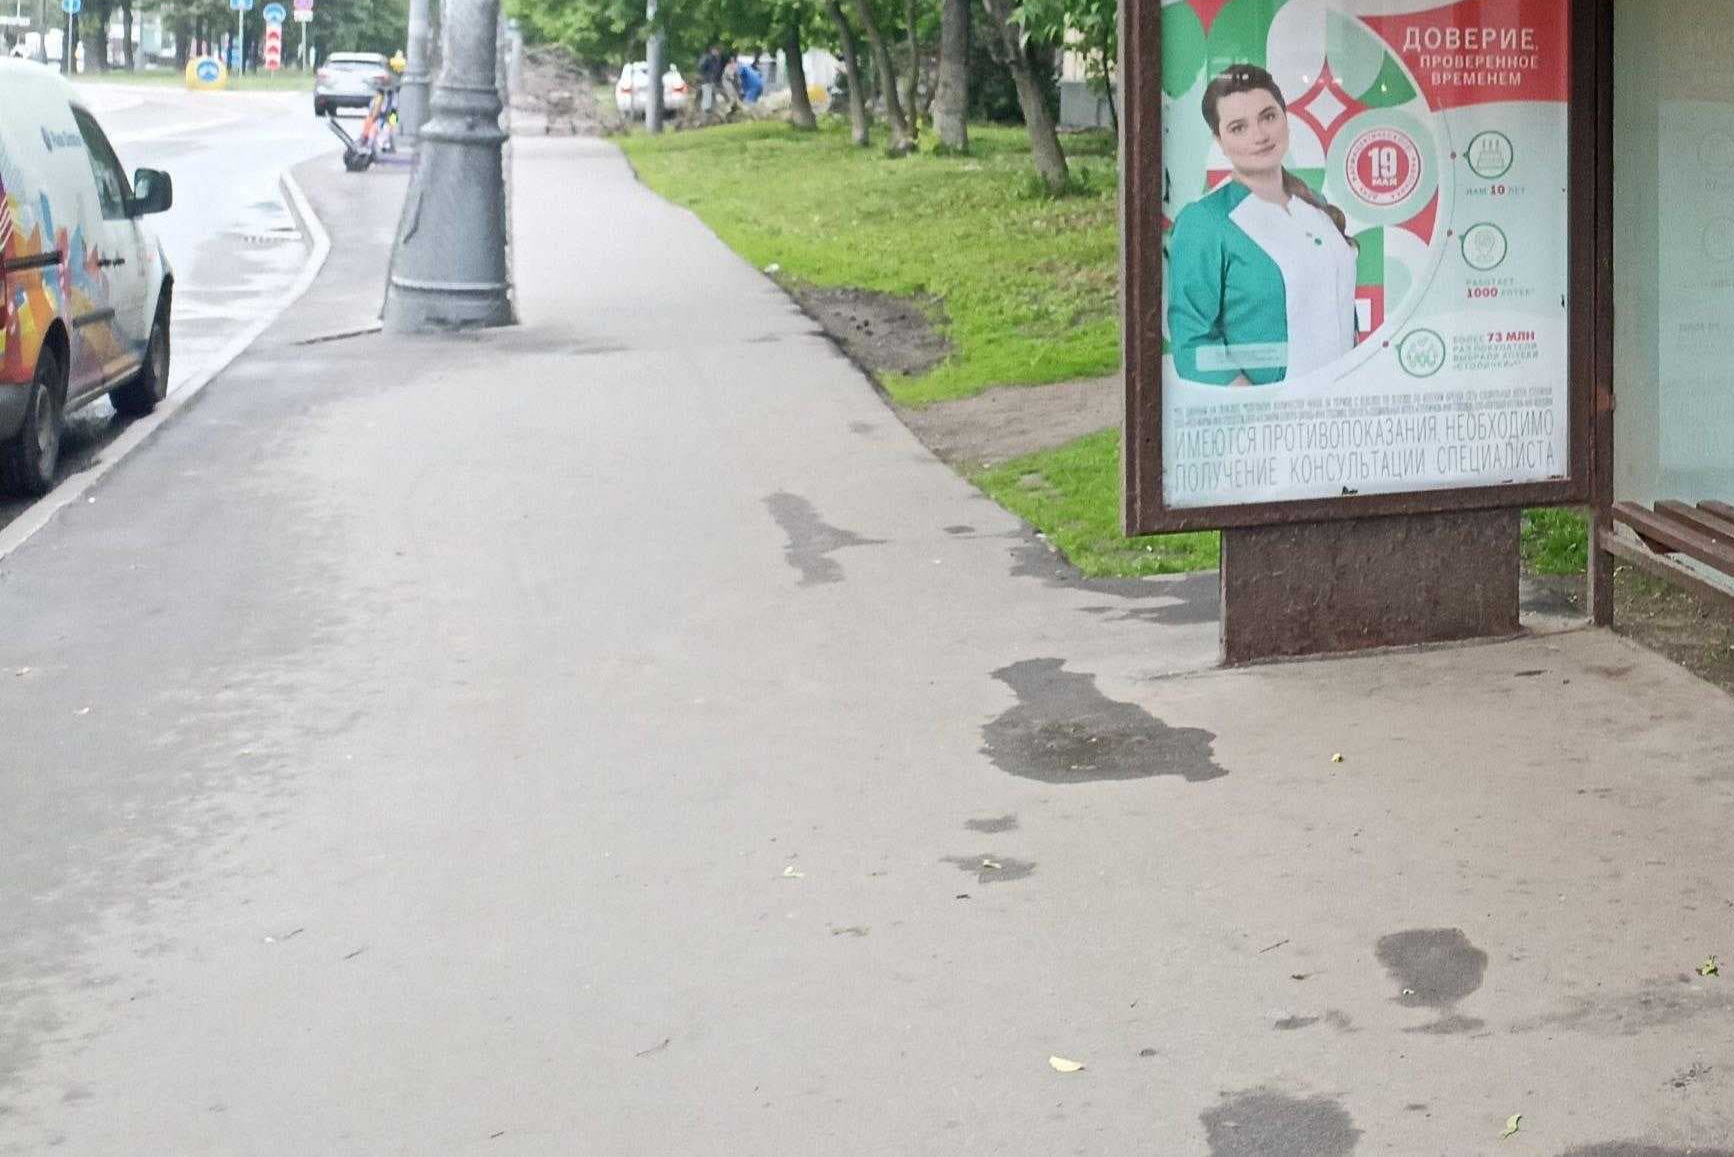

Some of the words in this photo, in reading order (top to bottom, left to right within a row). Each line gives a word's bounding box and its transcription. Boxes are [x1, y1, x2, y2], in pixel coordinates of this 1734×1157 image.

[1420, 54, 1539, 70] ПРОВЕРЕННОЕ
[1431, 71, 1522, 86] ВРЕМЕНЕМ
[1368, 147, 1398, 179] 19
[1490, 185, 1505, 195] 10
[1467, 287, 1499, 298] 1000
[1486, 331, 1504, 343] 73
[1506, 330, 1536, 342] МЛН
[1175, 426, 1256, 459] ИМЕЮТСЯ
[1446, 410, 1554, 442] НЕОБХОДИМО
[1175, 456, 1278, 492] ПОЛУЧЕНИЕ
[1290, 446, 1426, 484] КОНСУЛЬТАЦИИ
[1437, 440, 1555, 474] СПЕЦИАЛИСТА
